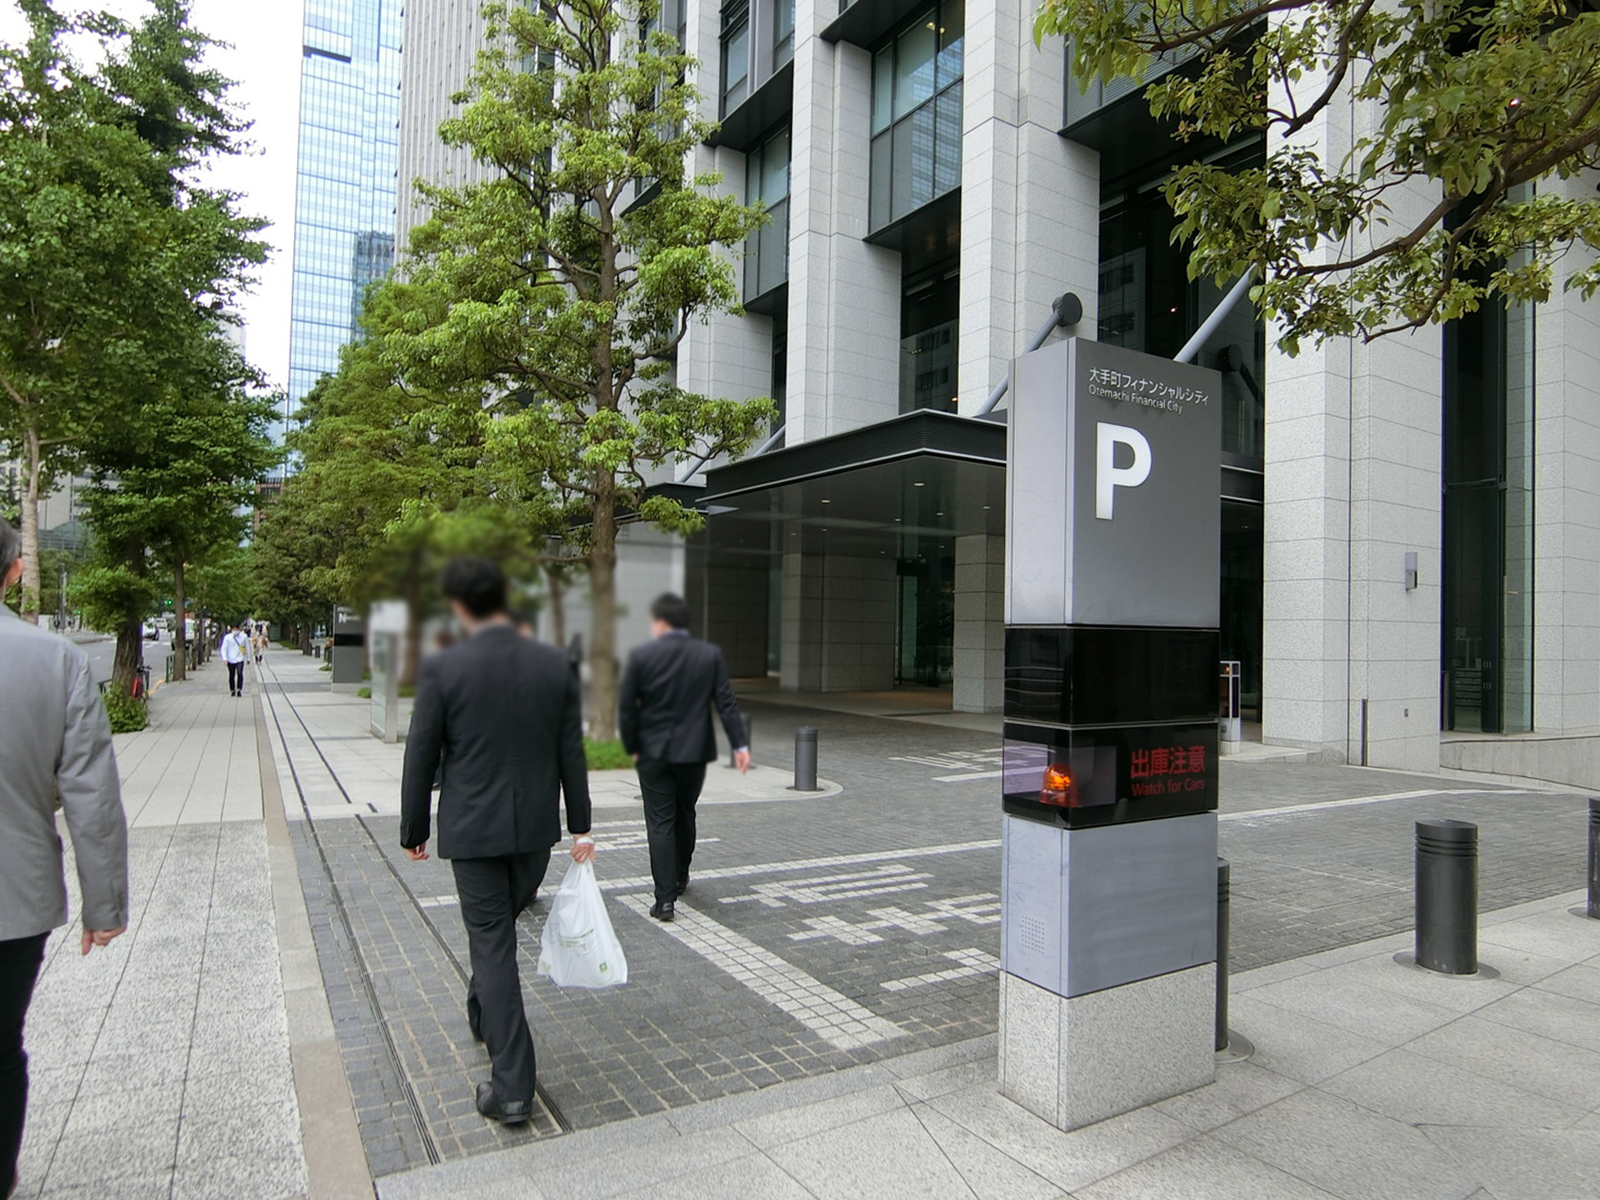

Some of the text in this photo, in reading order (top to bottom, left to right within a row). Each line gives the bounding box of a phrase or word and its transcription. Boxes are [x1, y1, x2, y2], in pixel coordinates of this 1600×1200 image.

[1088, 384, 1183, 415] Otemachi Financial City
[1089, 367, 1209, 405] 大手町フィナンシャルシティ
[1096, 422, 1152, 520] P
[1131, 746, 1206, 778] 出庫注意
[1131, 778, 1205, 796] Watch for Cars
